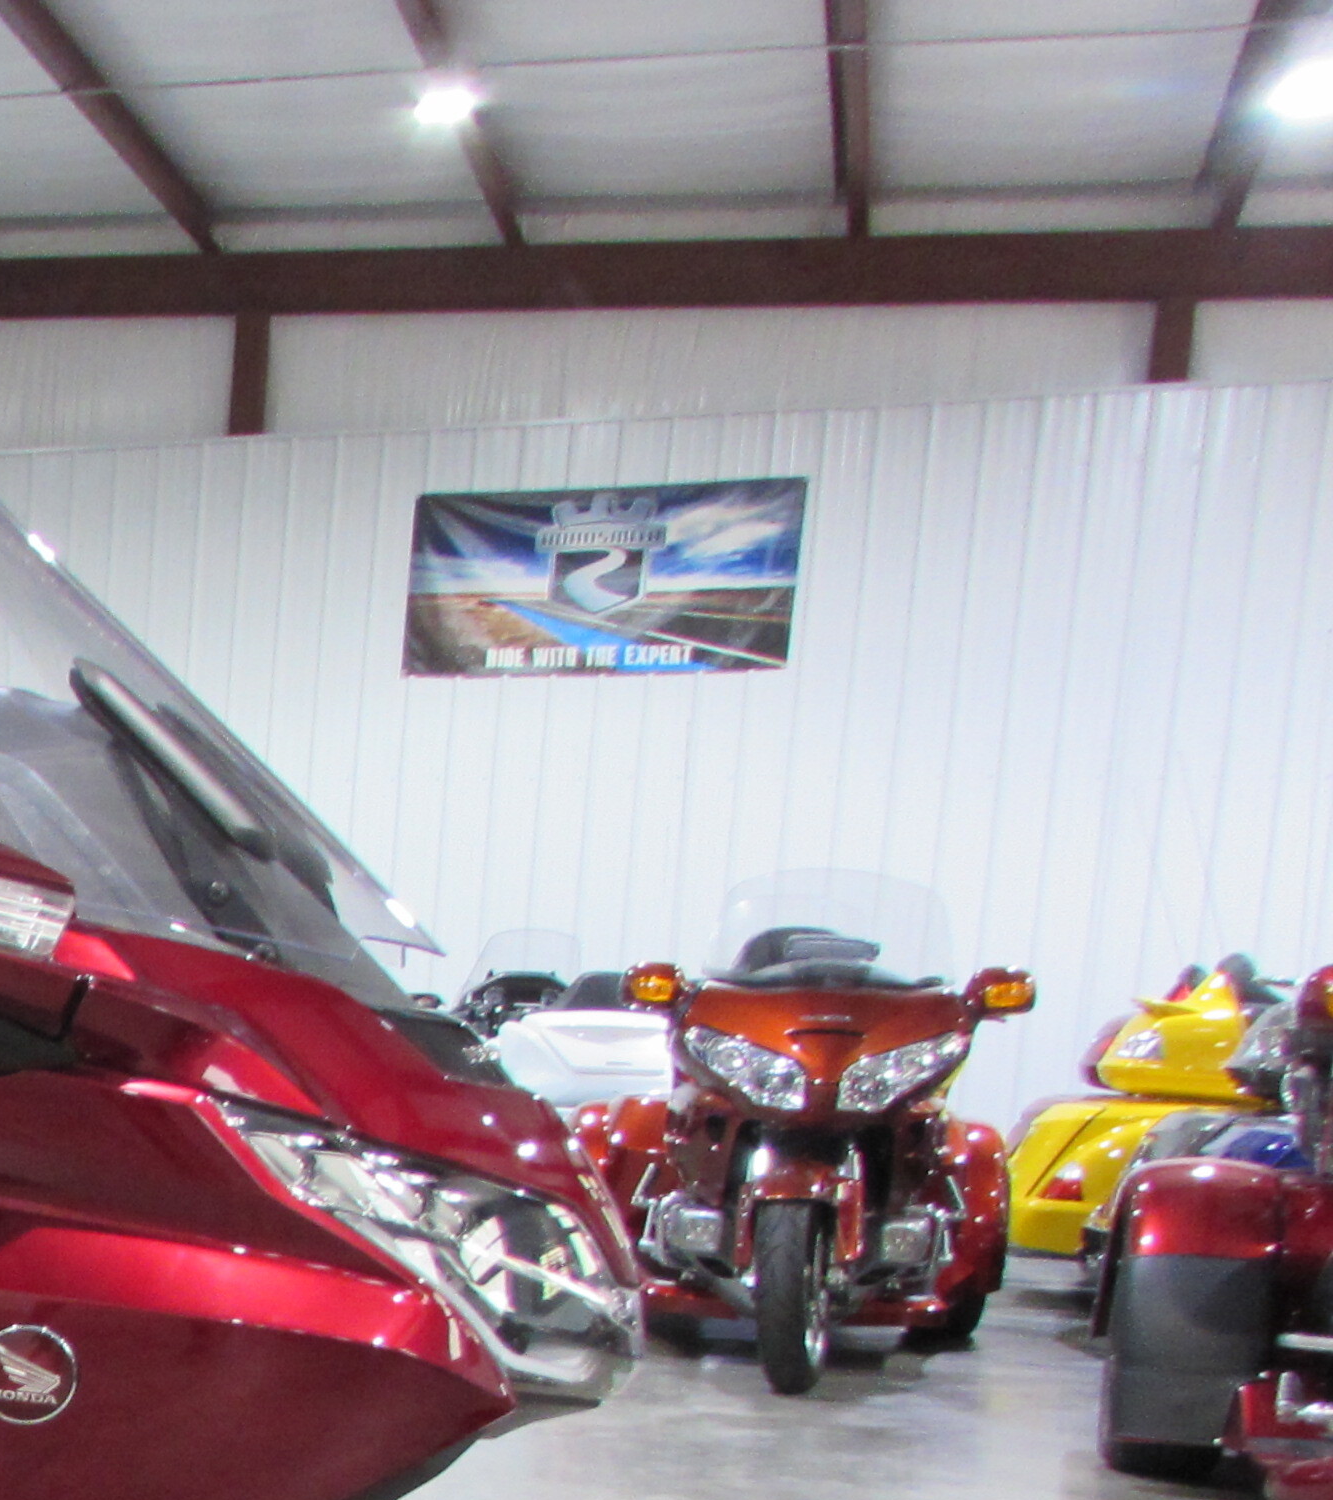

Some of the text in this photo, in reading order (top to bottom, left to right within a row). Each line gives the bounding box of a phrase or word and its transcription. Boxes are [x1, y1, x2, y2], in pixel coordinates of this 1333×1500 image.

[485, 644, 693, 669] RIDE WITH THE EXPERT
